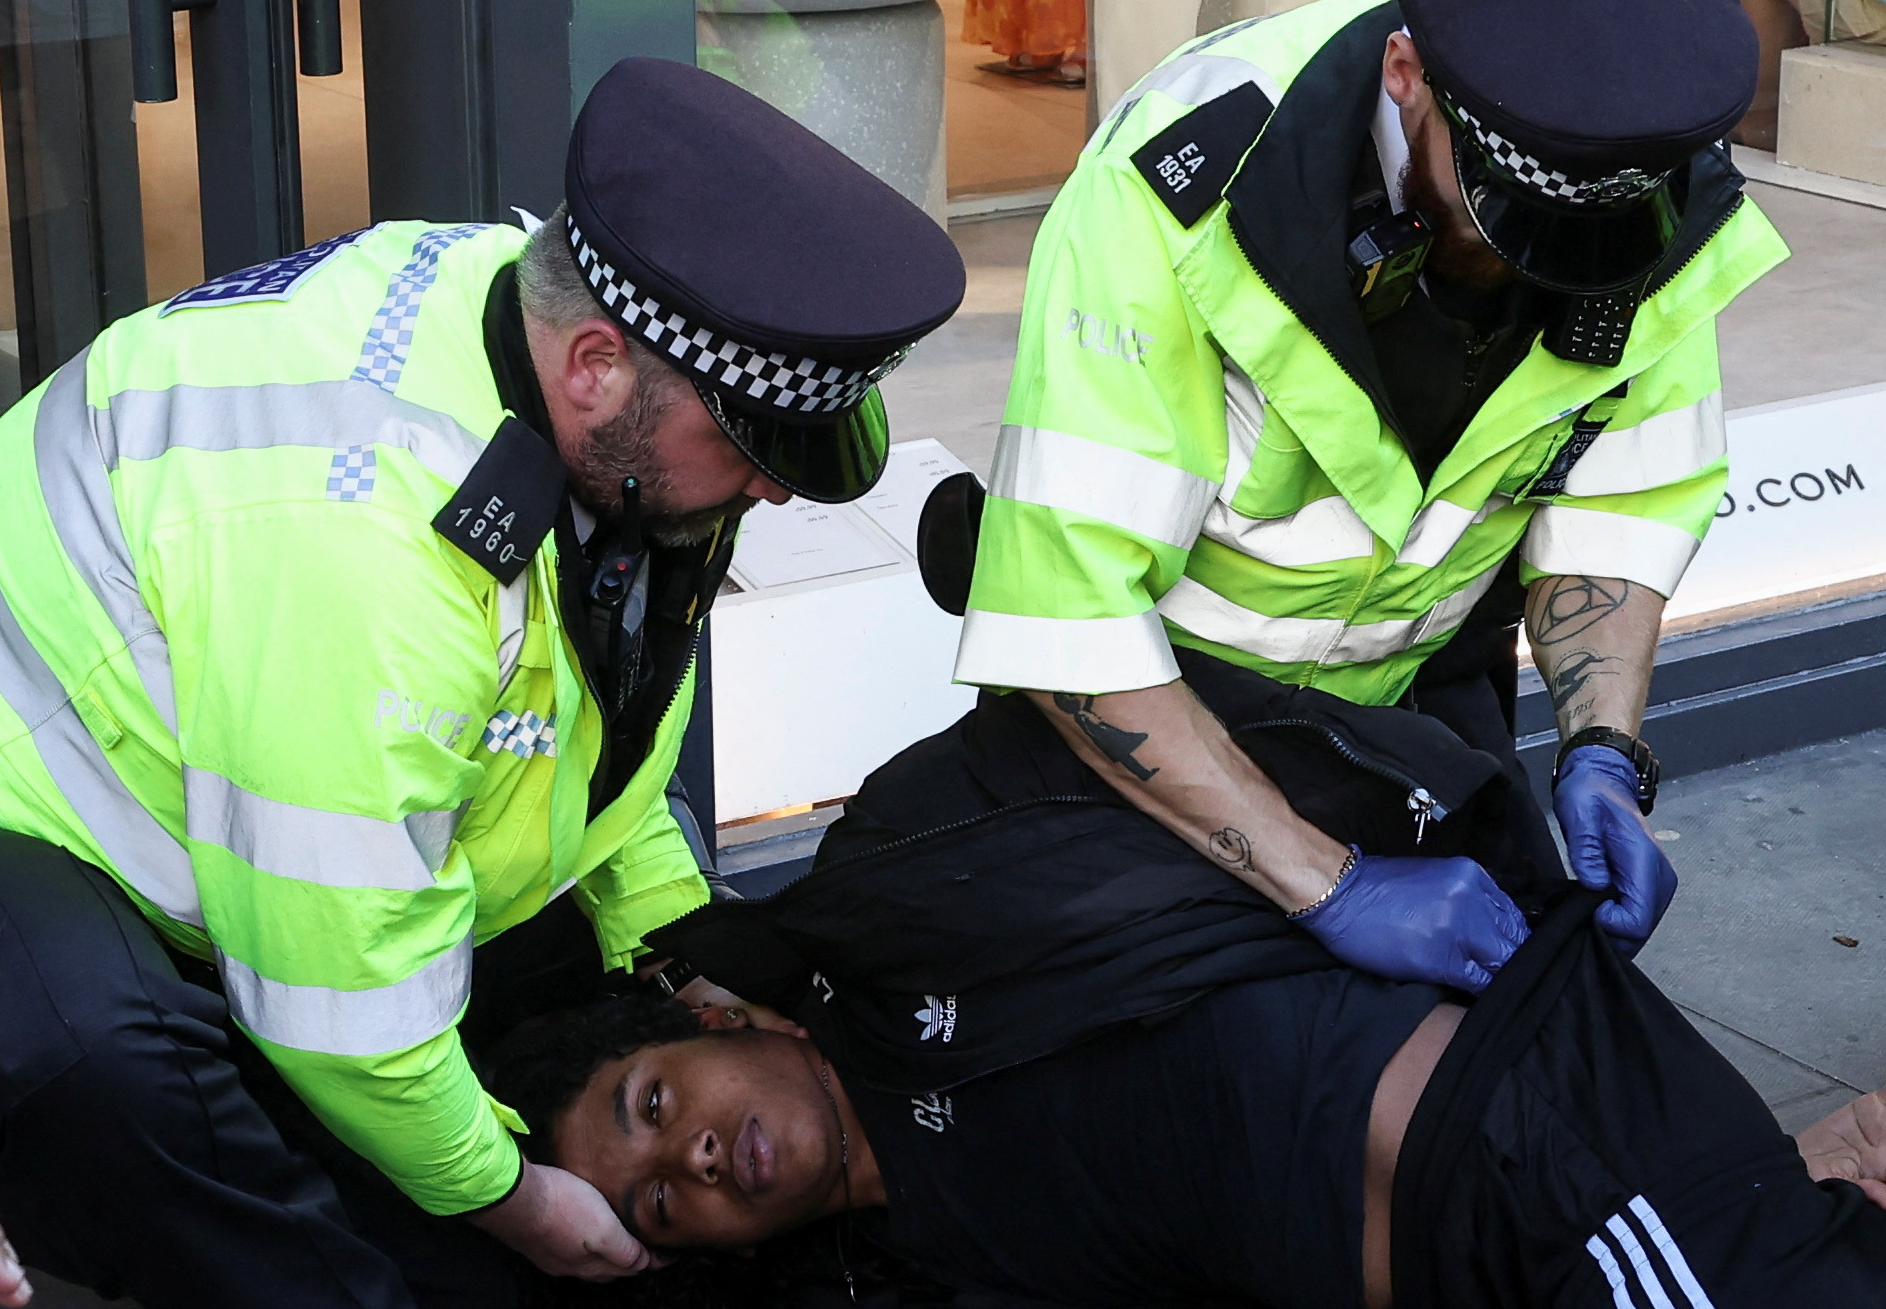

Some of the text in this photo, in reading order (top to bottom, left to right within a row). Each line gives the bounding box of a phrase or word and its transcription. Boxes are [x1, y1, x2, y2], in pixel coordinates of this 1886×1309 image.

[1155, 154, 1192, 194] 1931
[1177, 142, 1205, 174] EA
[483, 495, 516, 532] EA
[455, 507, 515, 564] 1960
[375, 689, 471, 749] POICE
